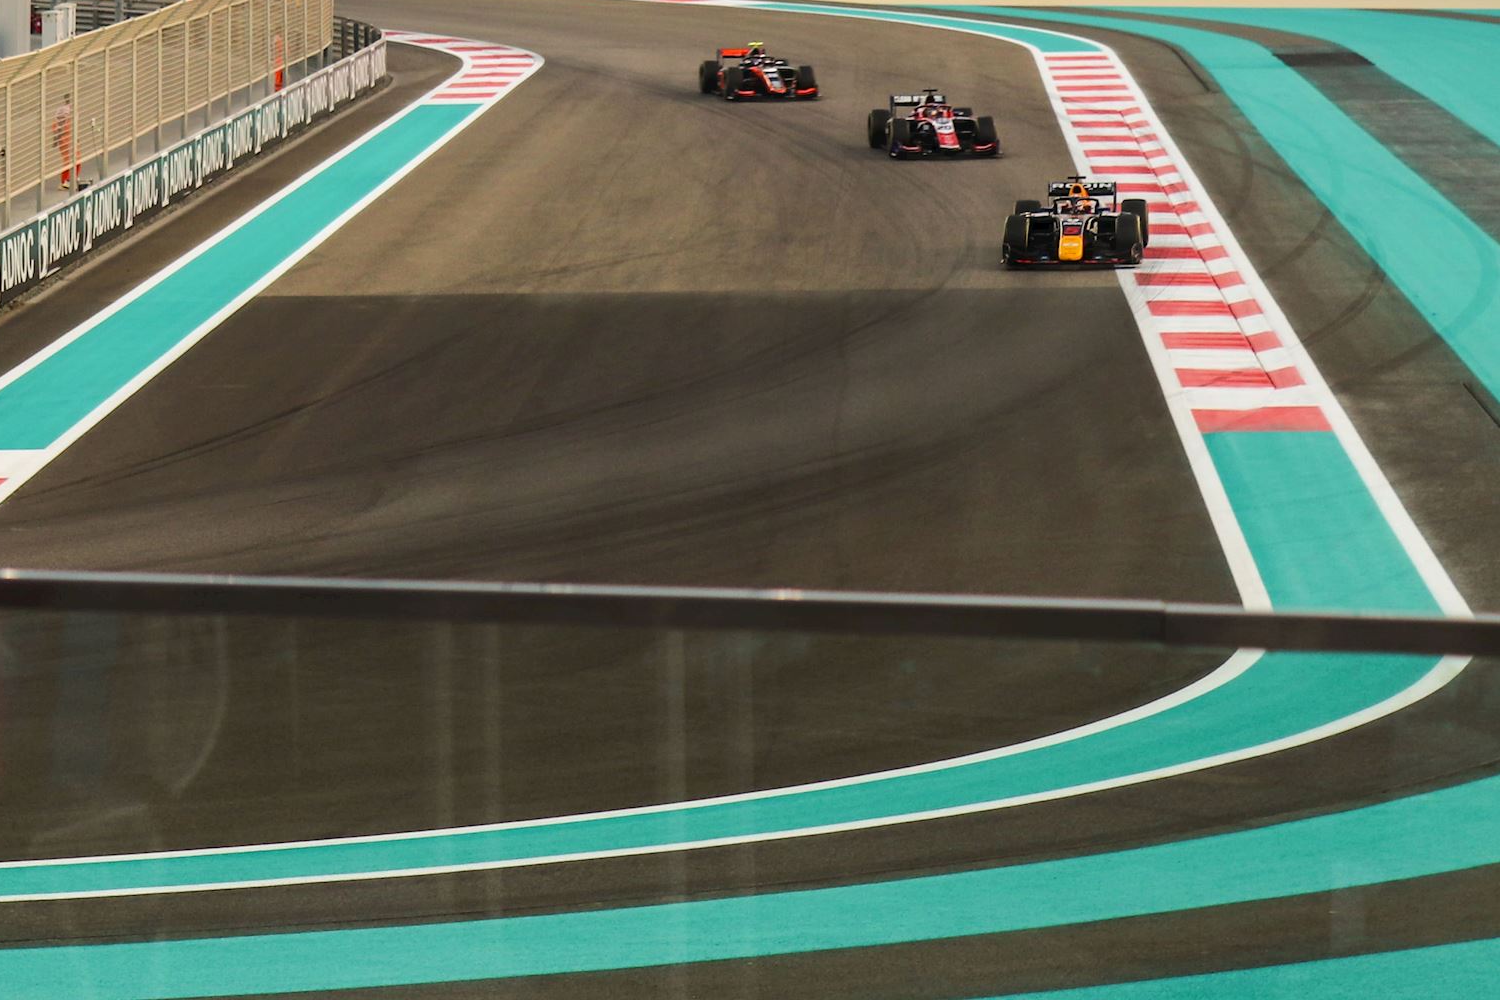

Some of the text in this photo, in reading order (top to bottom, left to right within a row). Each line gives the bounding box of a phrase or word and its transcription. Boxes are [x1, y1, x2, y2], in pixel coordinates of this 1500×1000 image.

[133, 161, 159, 217] ADNOC
[169, 144, 194, 197] ADNOC
[50, 203, 81, 260] ADNOC
[92, 182, 121, 240] ADNOC
[1, 228, 35, 293] ADNOC
